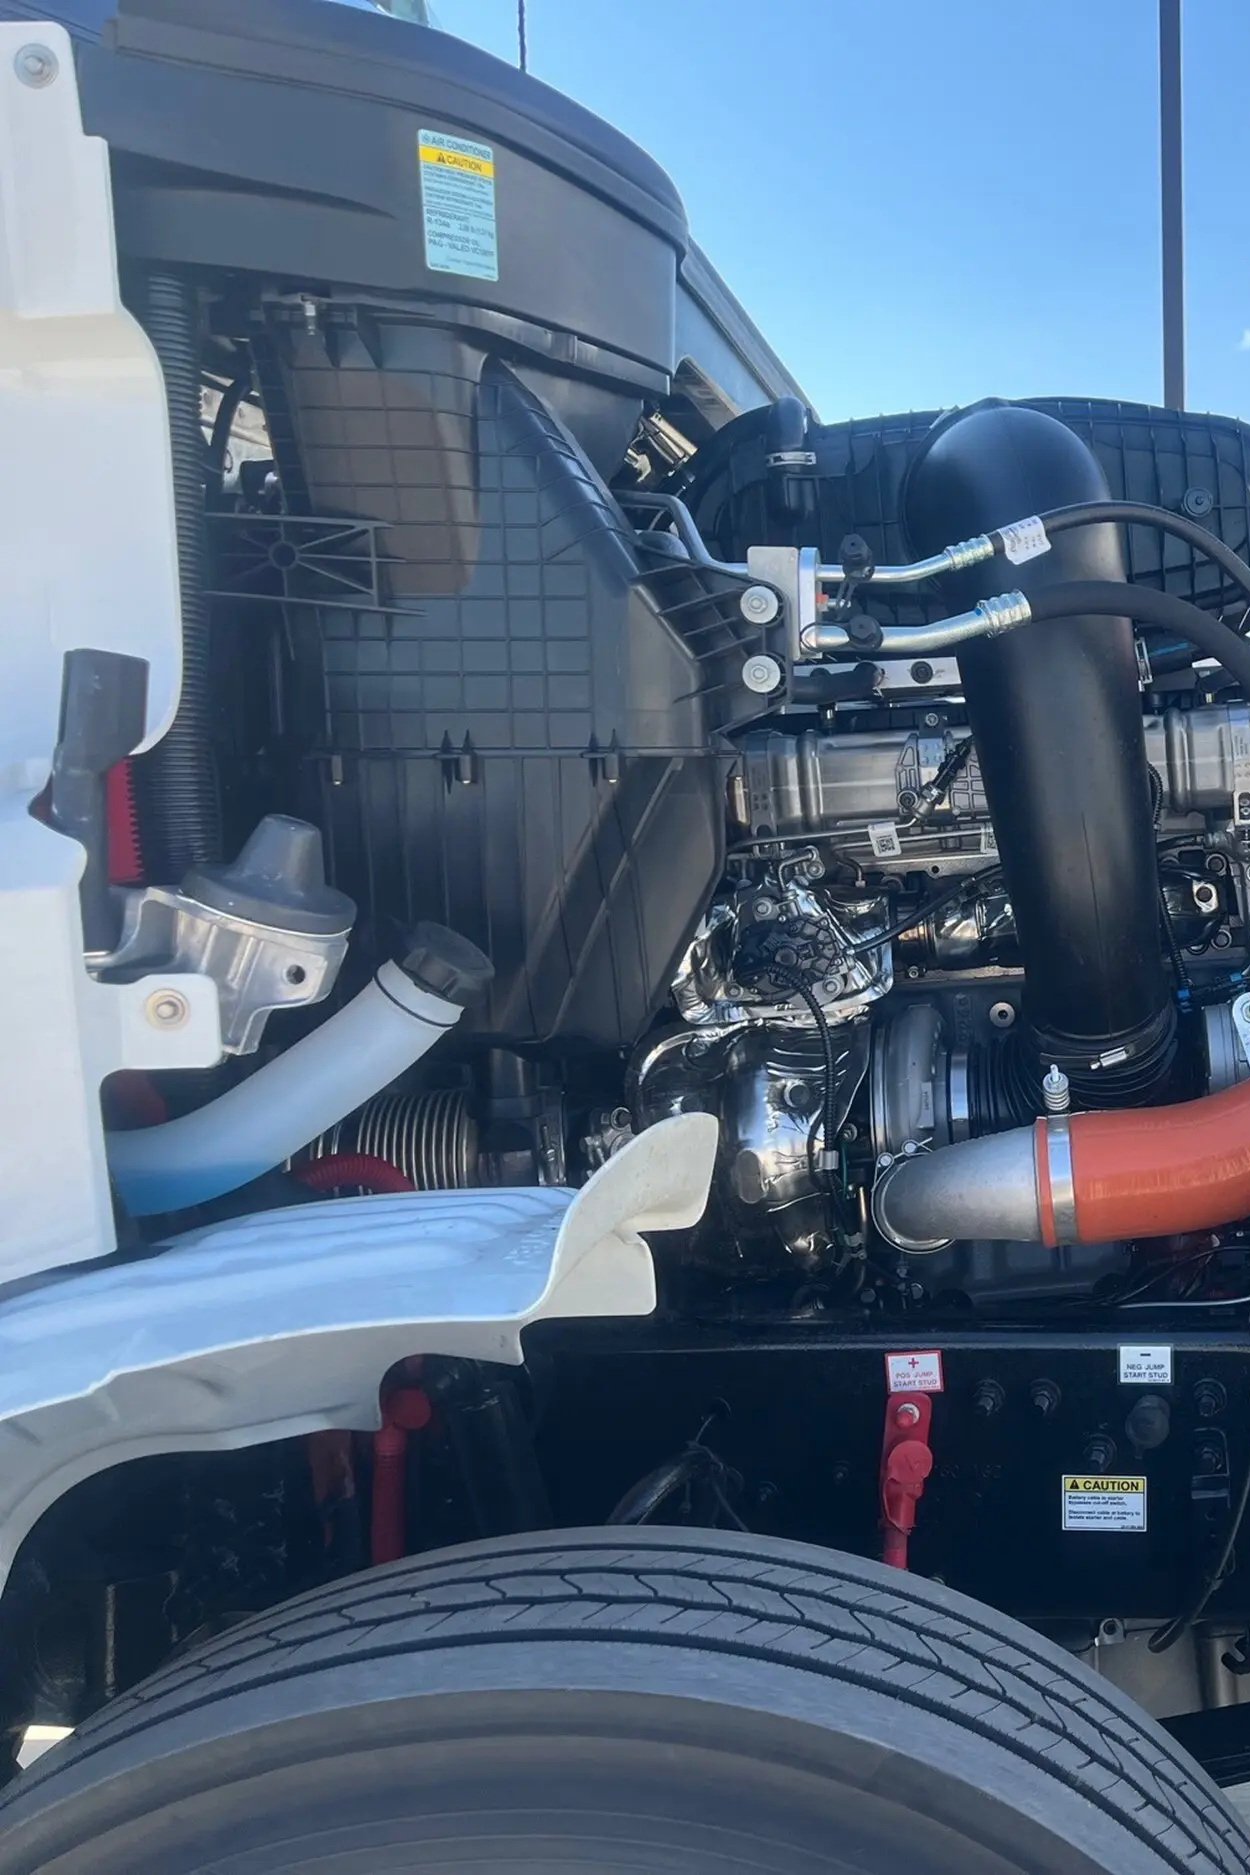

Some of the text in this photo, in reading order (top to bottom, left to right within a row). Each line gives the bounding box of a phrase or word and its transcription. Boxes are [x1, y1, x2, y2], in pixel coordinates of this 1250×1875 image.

[431, 136, 491, 160] AIR CONDITIONER
[446, 155, 482, 172] CAUTION
[1123, 1371, 1169, 1379] START STUD
[893, 1380, 916, 1388] START
[1083, 1480, 1140, 1491] CAUTION
